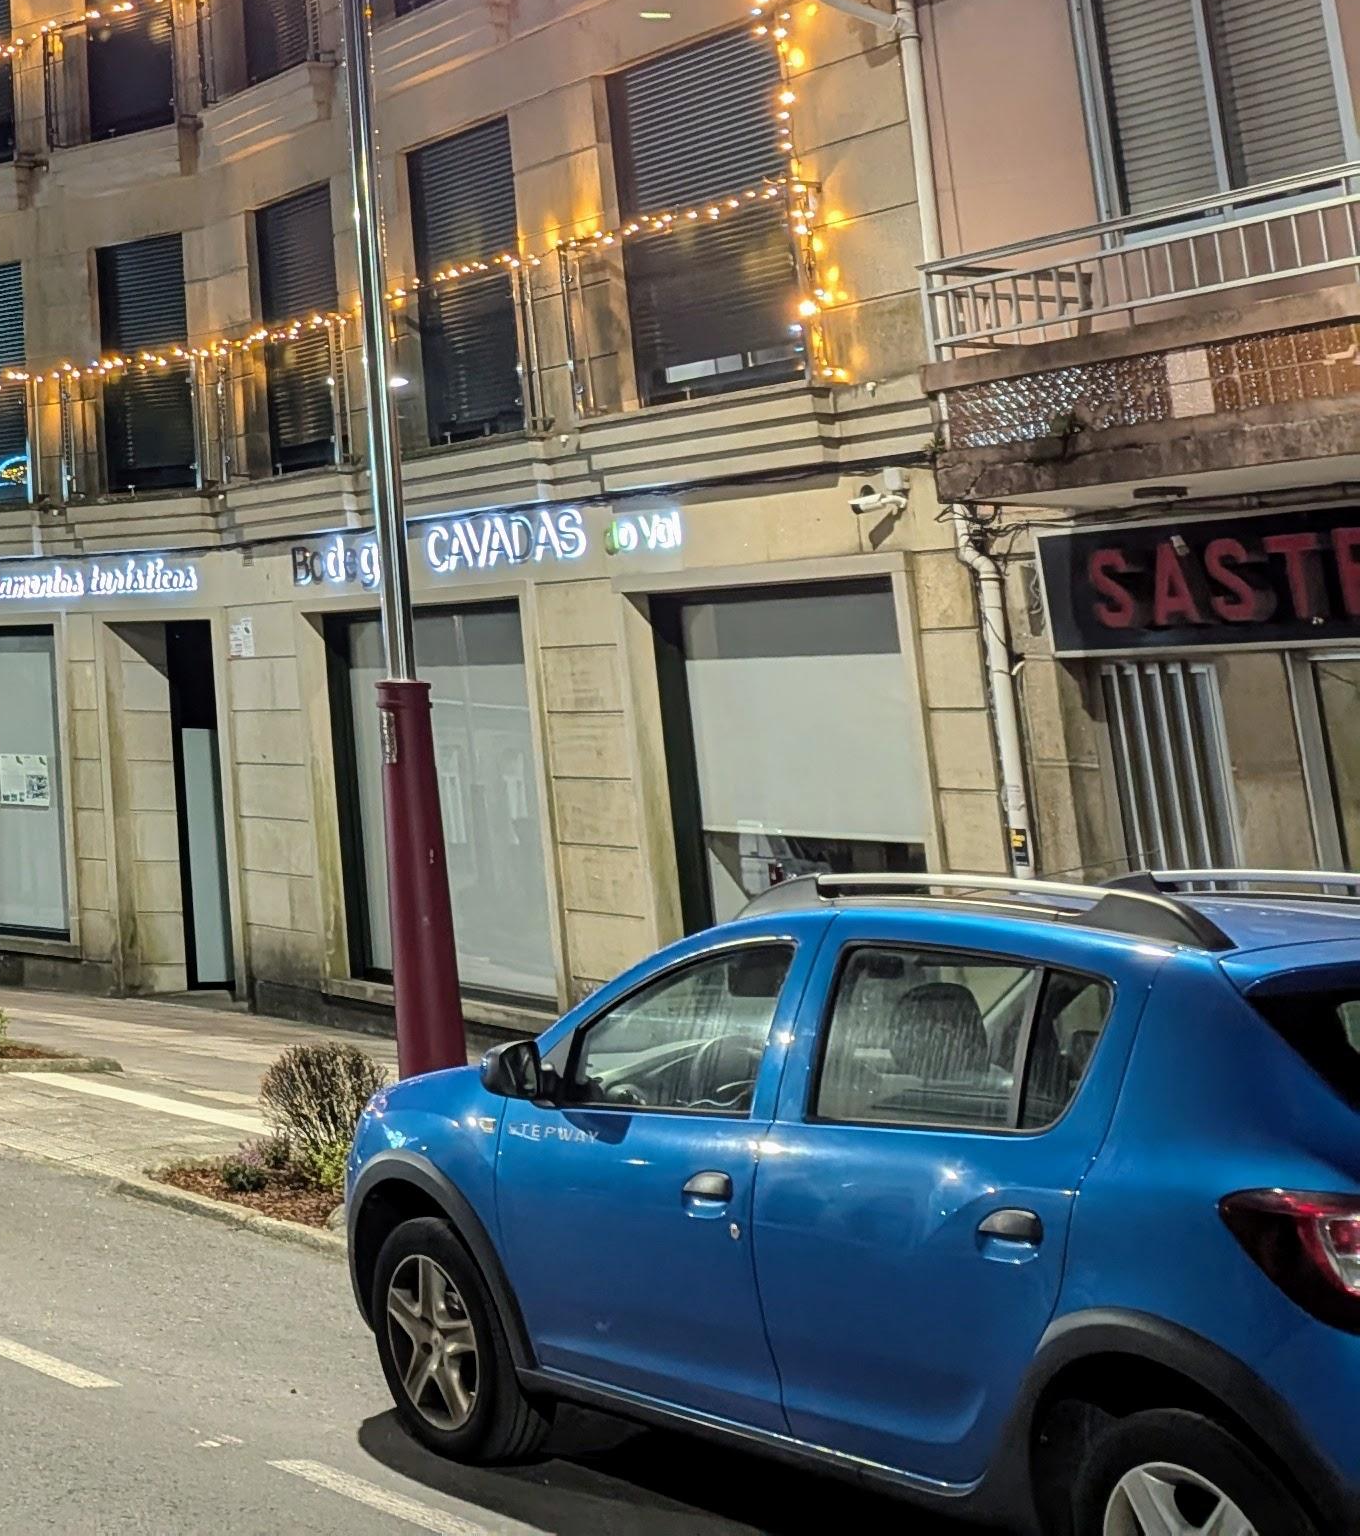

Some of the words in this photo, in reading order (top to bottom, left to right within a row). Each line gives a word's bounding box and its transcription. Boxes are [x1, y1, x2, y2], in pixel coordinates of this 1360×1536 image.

[292, 535, 380, 588] Bodeg
[426, 508, 587, 573] CAVADAS
[604, 519, 637, 556] do
[637, 511, 682, 550] Val
[508, 1123, 600, 1144] STEPWAY
